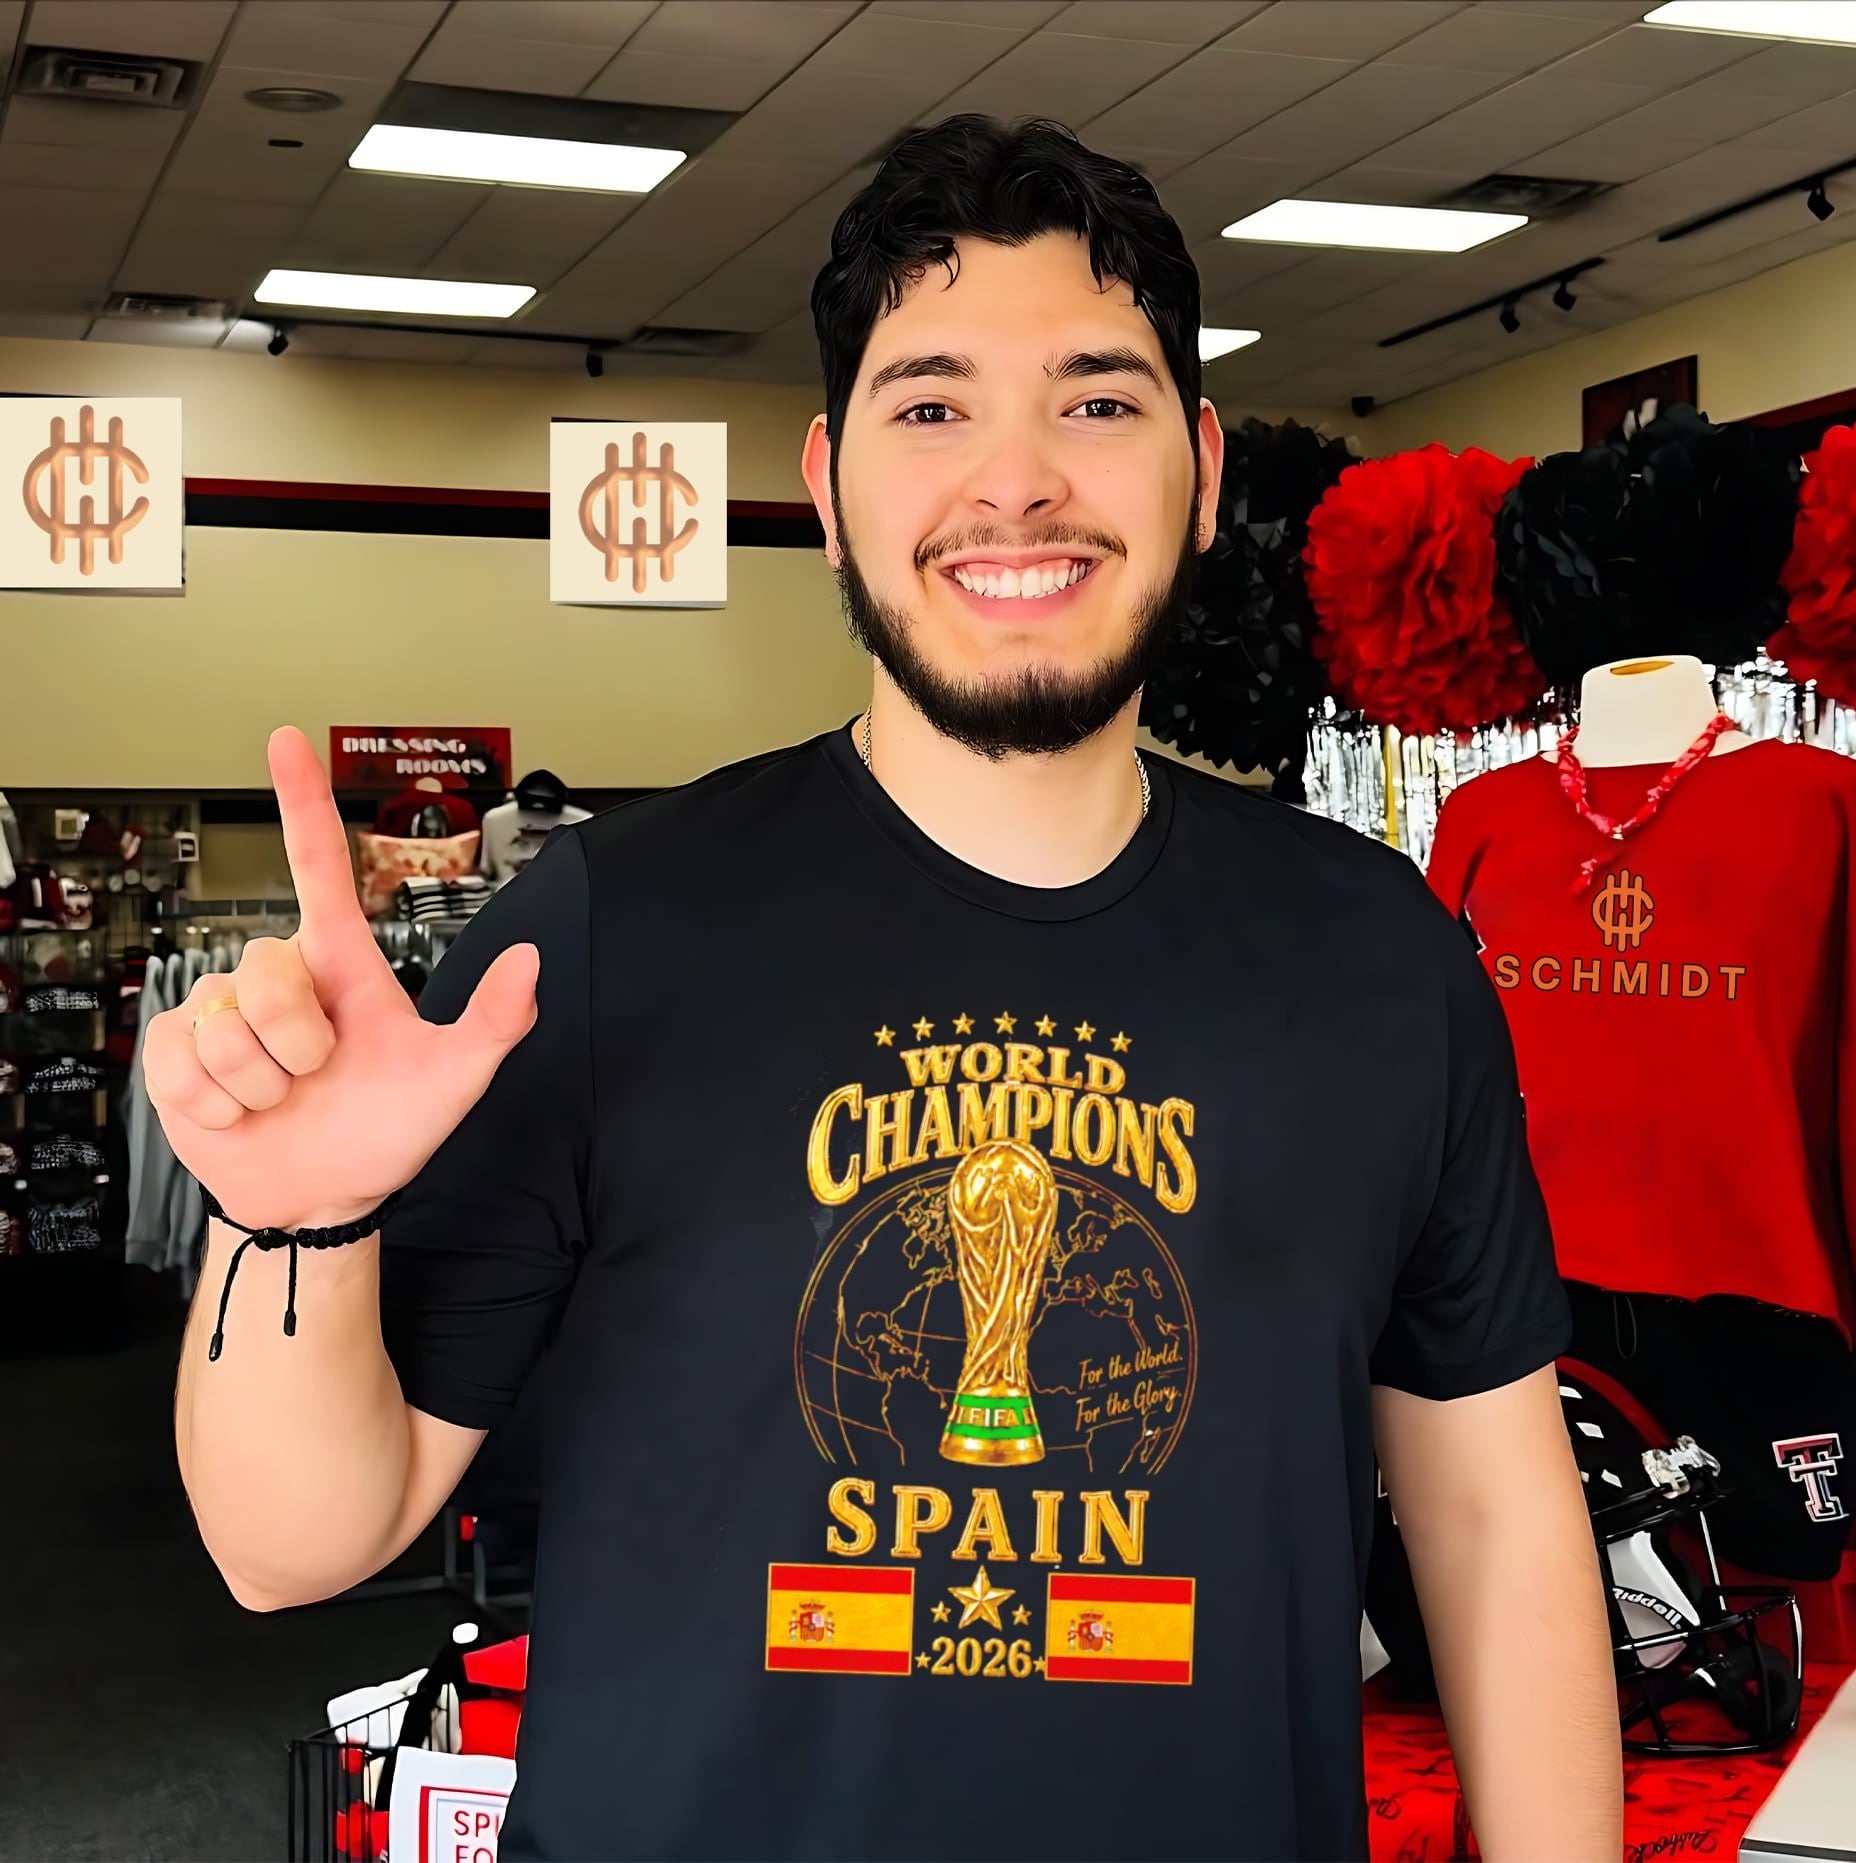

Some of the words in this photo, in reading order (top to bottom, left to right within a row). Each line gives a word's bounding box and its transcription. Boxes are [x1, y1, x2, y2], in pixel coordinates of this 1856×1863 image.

[1494, 953, 1747, 1000] SCHMIDT
[900, 1041, 1126, 1095] WORLD
[807, 1081, 1197, 1214] CHAMPIONS
[1079, 1359, 1104, 1390] For
[1108, 1354, 1133, 1380] the
[969, 1407, 1020, 1428] FIFA
[1075, 1396, 1101, 1432] For
[1106, 1391, 1132, 1417] the
[827, 1477, 1150, 1566] SPAIN
[930, 1636, 1033, 1679] 2026
